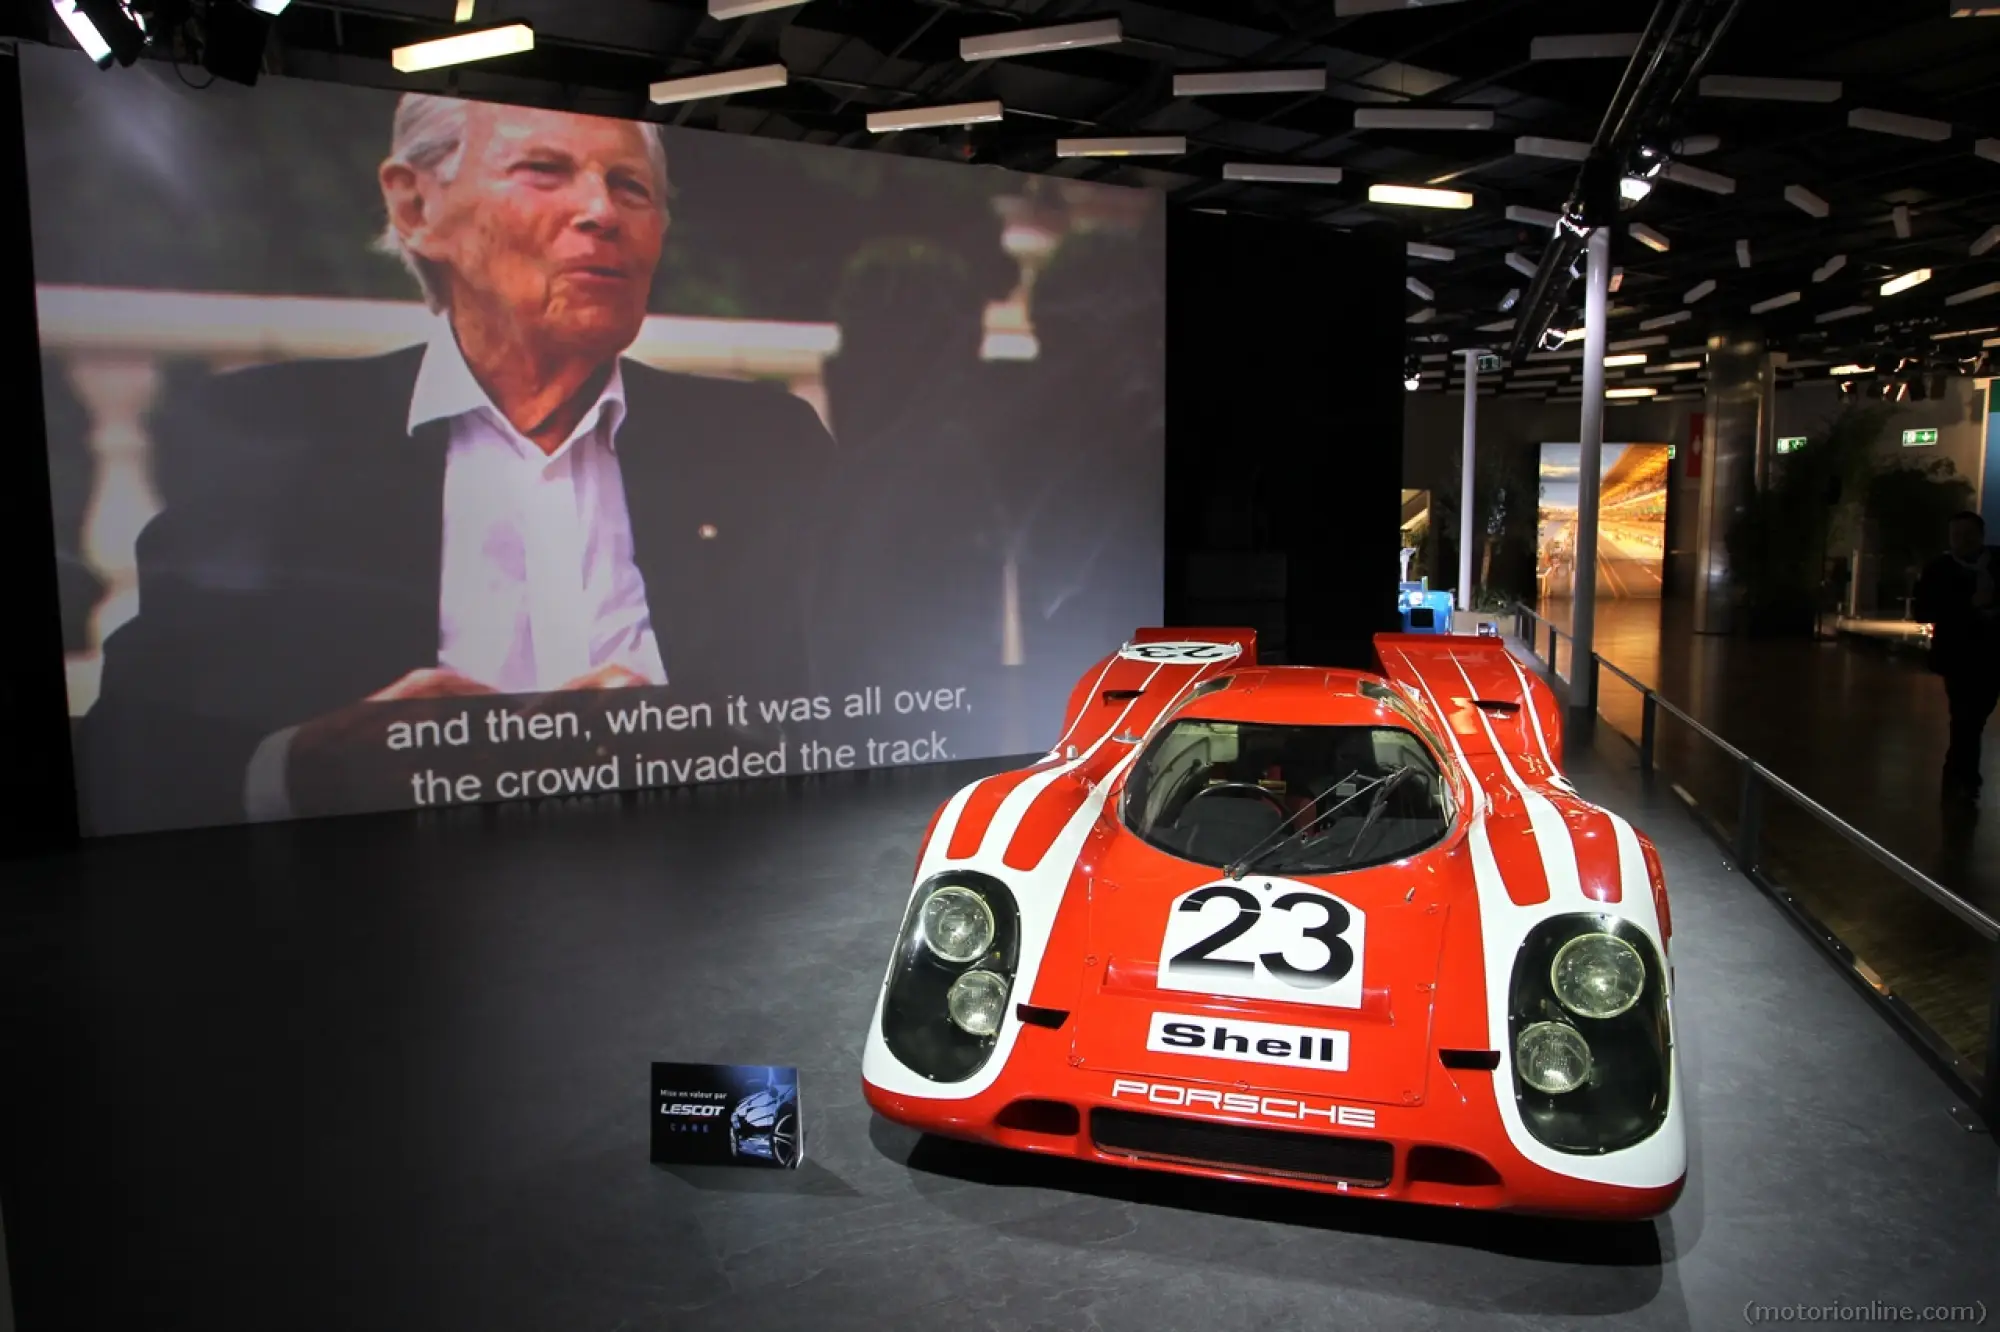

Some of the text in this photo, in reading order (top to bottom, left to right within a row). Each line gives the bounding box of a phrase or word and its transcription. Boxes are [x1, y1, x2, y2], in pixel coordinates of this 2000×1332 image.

[386, 686, 972, 749] and then, when it was all over,
[411, 731, 957, 805] the crowd invaded the track.
[1169, 886, 1354, 989] 23
[1161, 1022, 1333, 1062] Shell
[660, 1089, 677, 1097] Mise
[690, 1090, 713, 1099] valeur
[714, 1092, 727, 1100] par
[660, 1103, 725, 1116] LESCOT
[1112, 1078, 1375, 1128] PORSCHE
